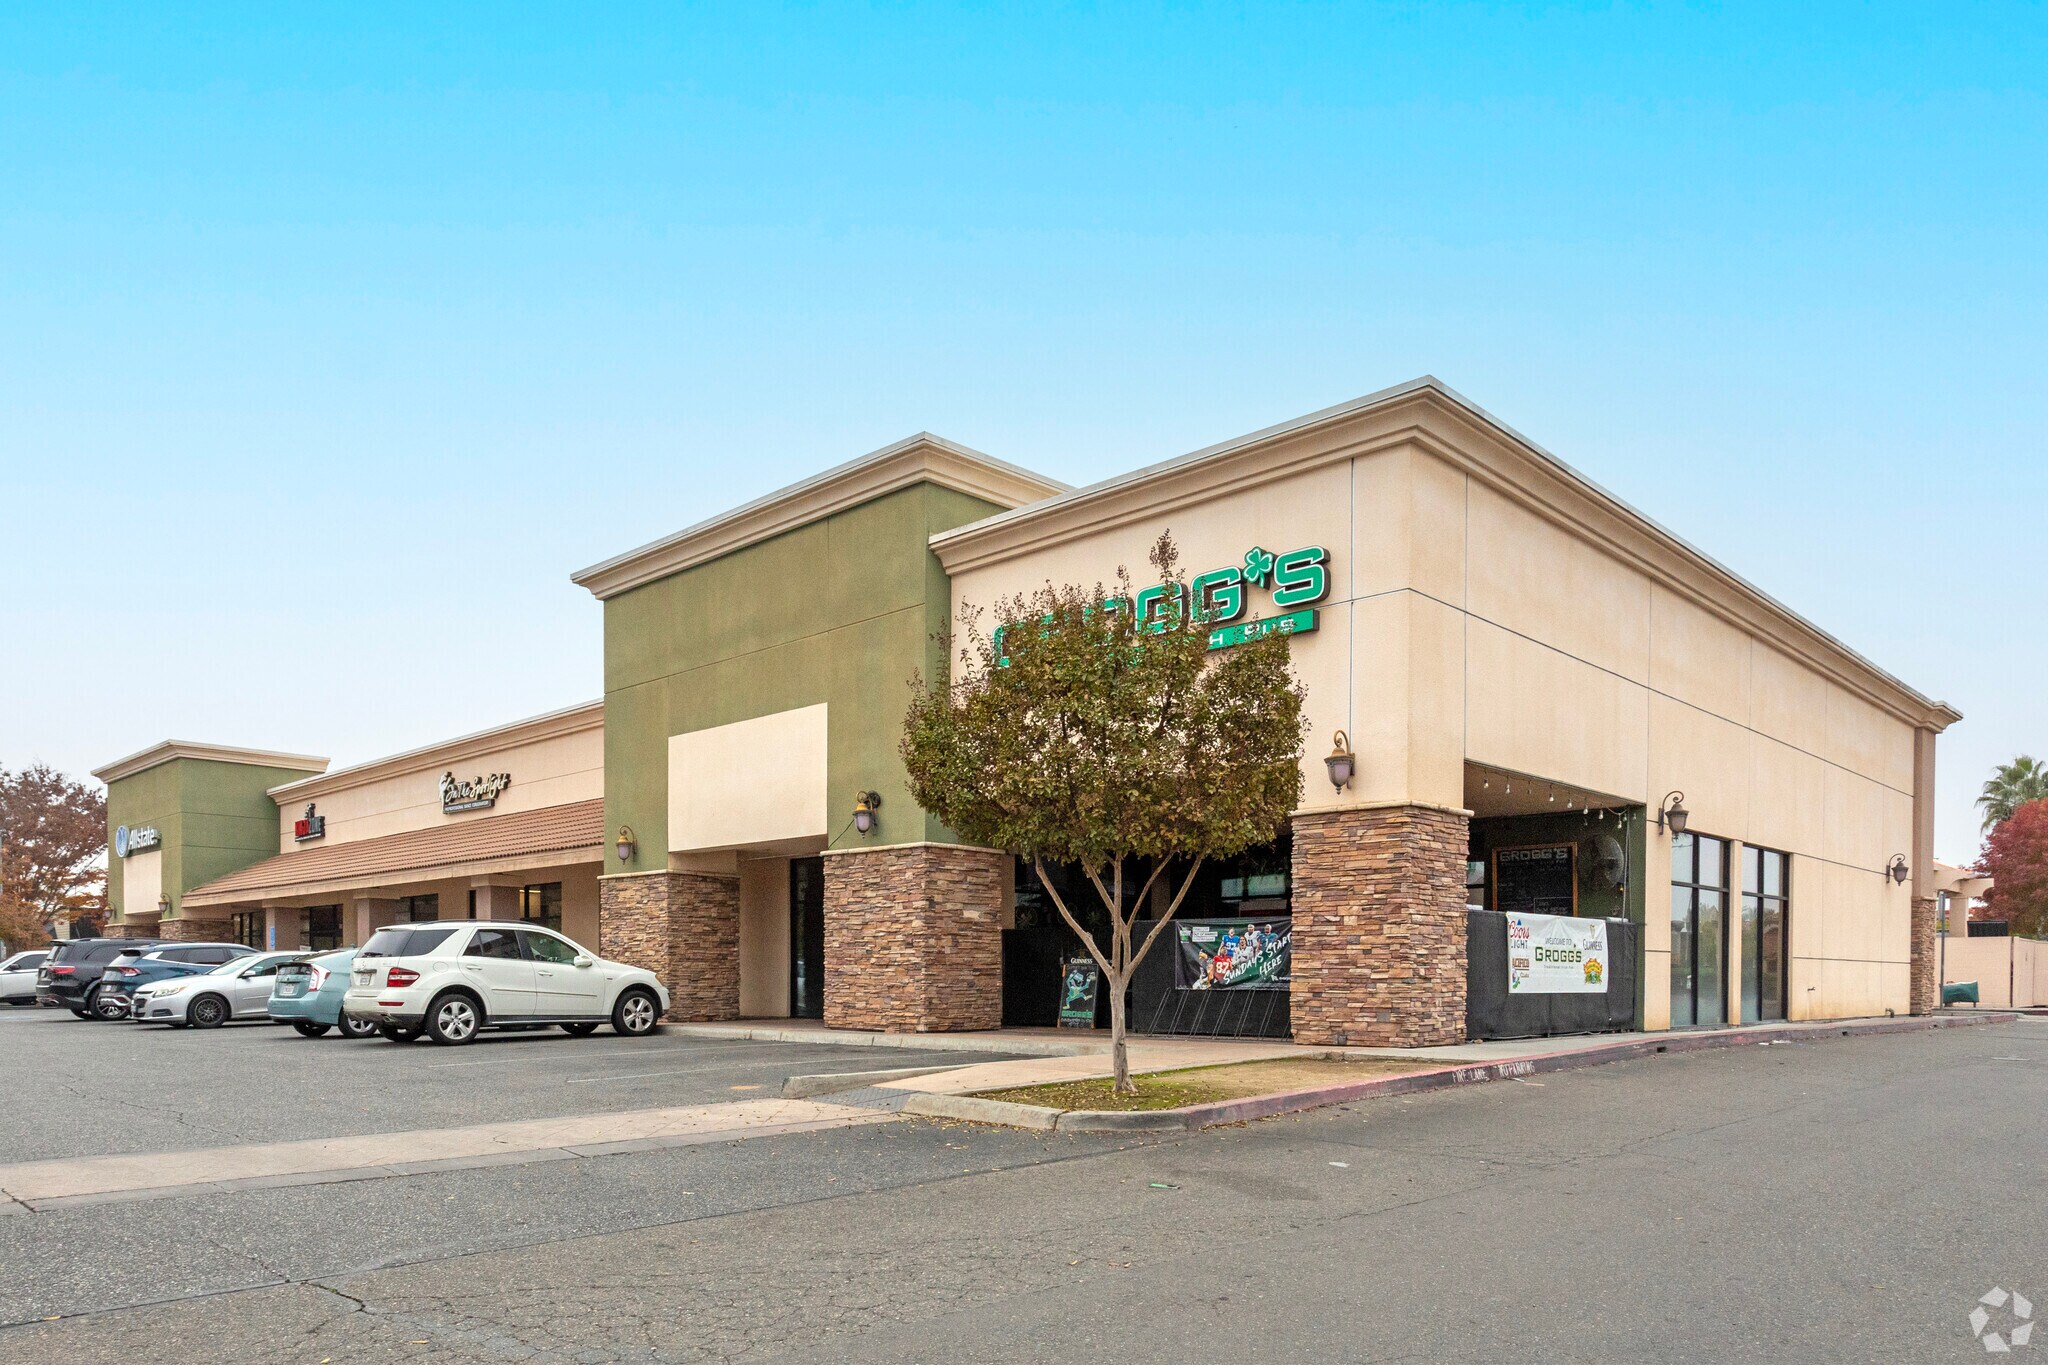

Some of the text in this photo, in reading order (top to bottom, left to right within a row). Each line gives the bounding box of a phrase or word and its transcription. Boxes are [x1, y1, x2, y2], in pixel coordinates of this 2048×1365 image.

[1216, 961, 1230, 974] 87
[1223, 932, 1292, 984] SUNDAYS START
[1260, 955, 1282, 976] HERE
